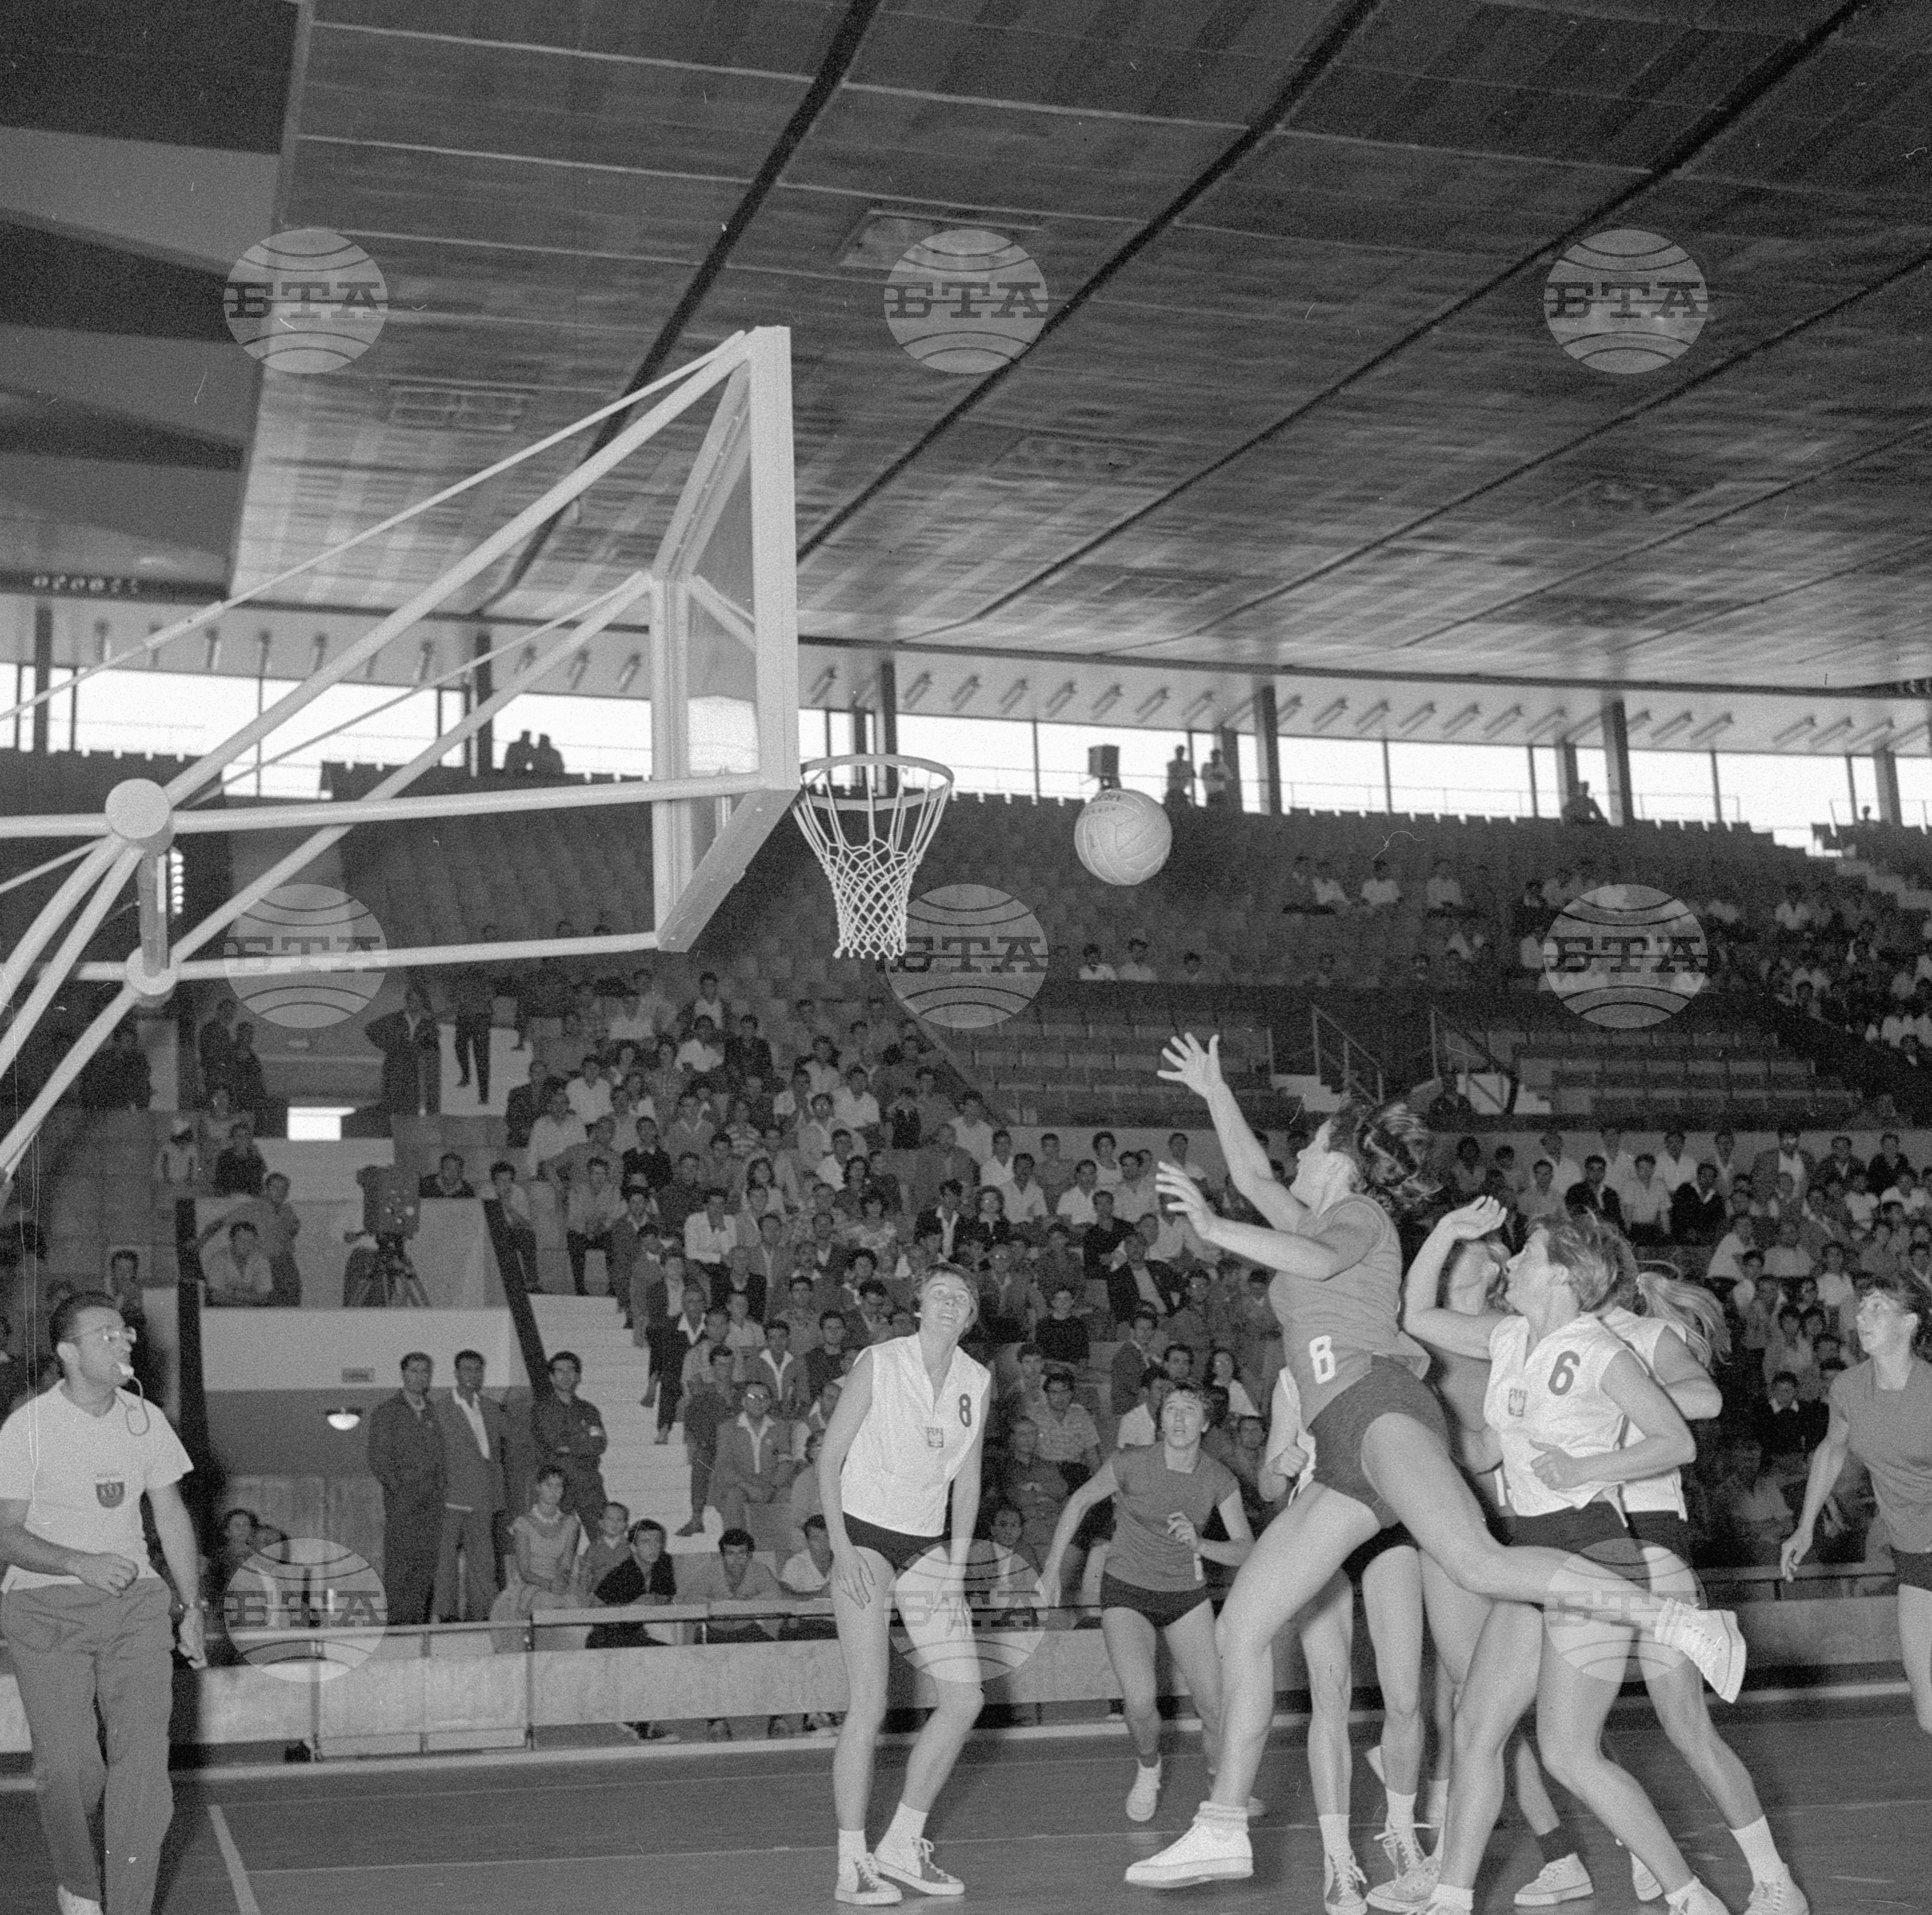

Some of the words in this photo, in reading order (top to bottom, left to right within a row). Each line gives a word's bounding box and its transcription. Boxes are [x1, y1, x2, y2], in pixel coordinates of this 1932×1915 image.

[1309, 1335, 1335, 1384] 8
[1548, 1351, 1580, 1396] 6
[959, 1393, 971, 1428] 8
